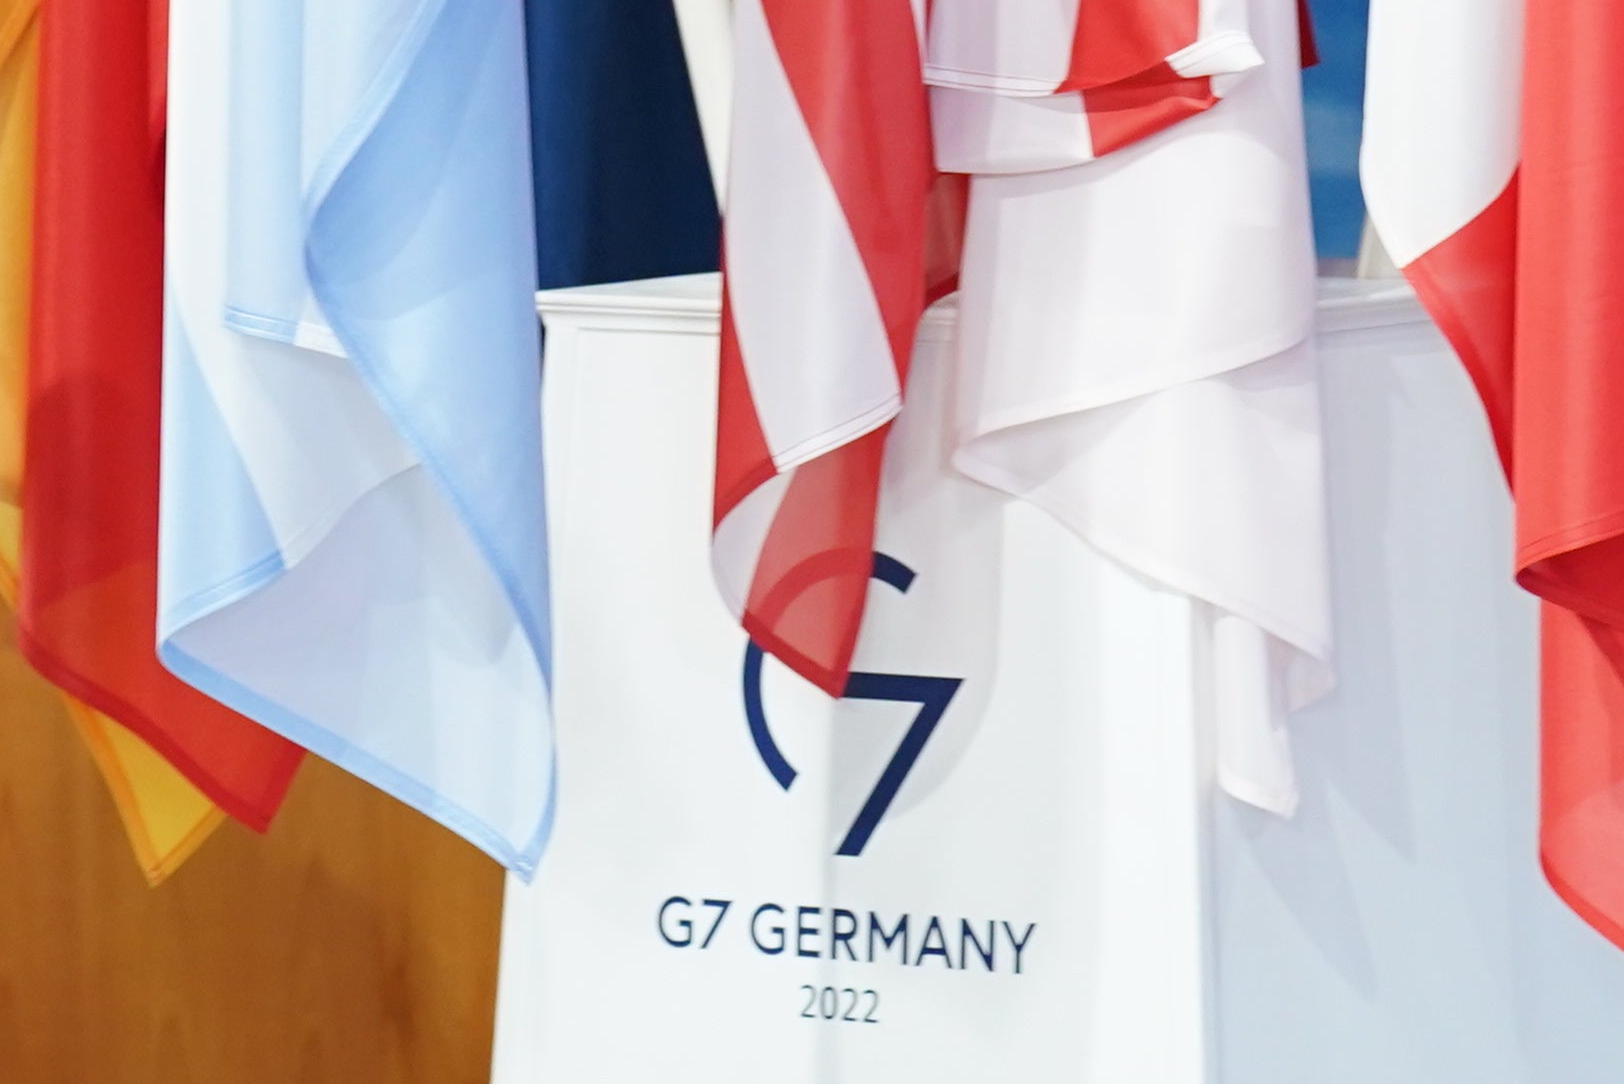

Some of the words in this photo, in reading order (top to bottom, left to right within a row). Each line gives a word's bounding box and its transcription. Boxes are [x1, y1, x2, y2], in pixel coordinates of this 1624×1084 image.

[657, 895, 733, 950] G7
[749, 902, 1037, 975] GERMANY
[799, 983, 880, 1024] 2022
